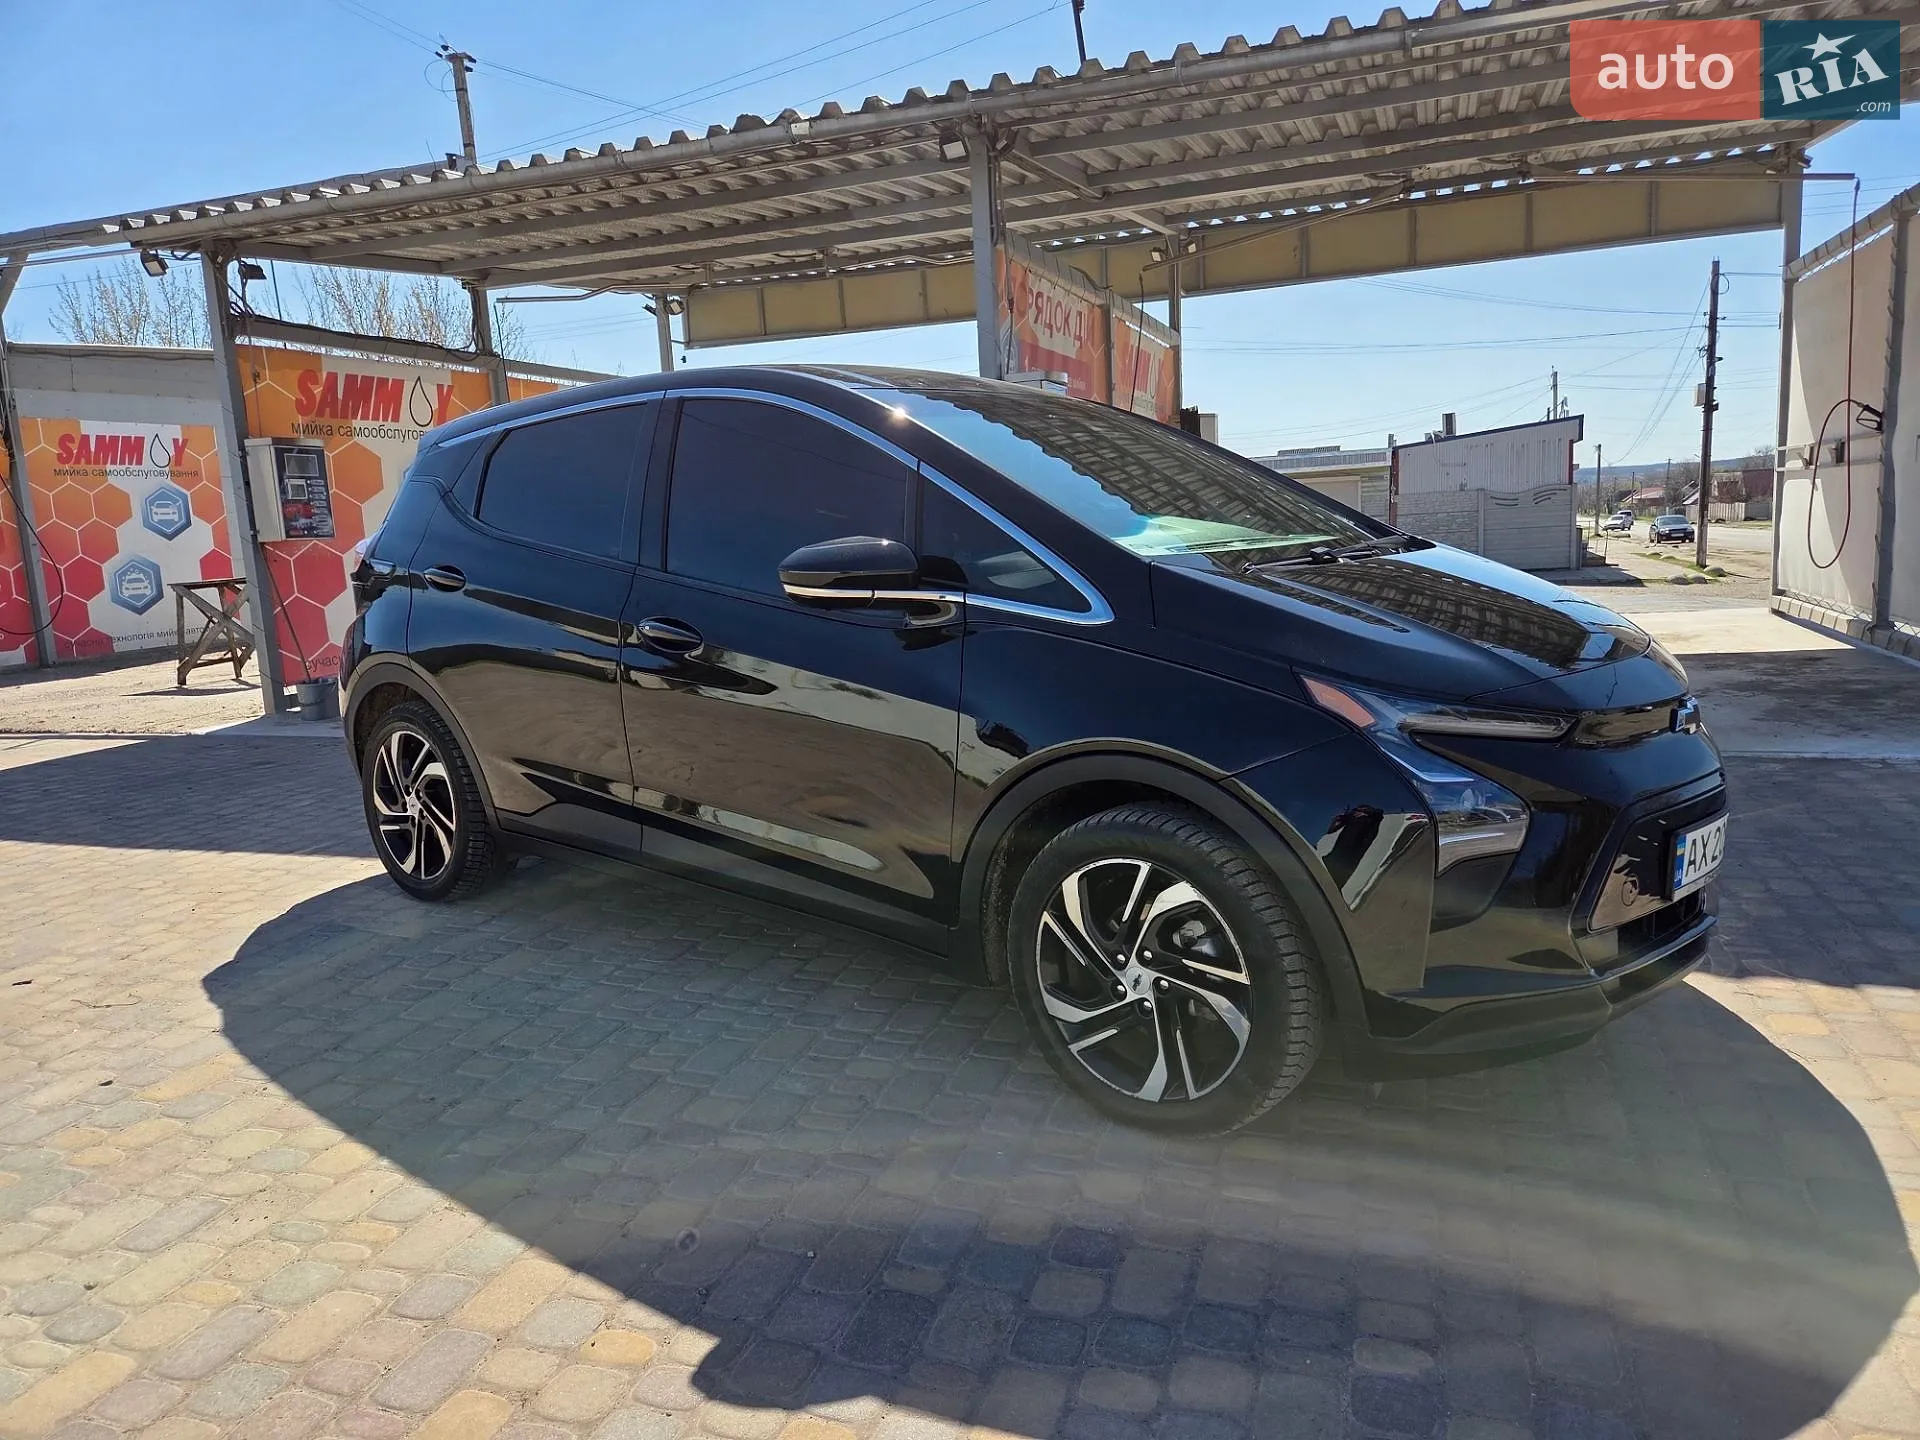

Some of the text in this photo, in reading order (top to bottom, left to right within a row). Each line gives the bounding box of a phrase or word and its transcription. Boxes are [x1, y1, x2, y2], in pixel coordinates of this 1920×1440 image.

[291, 420, 427, 443] мийка самообслугов
[53, 465, 199, 479] мийка самообслуговування
[306, 655, 341, 672] сучас
